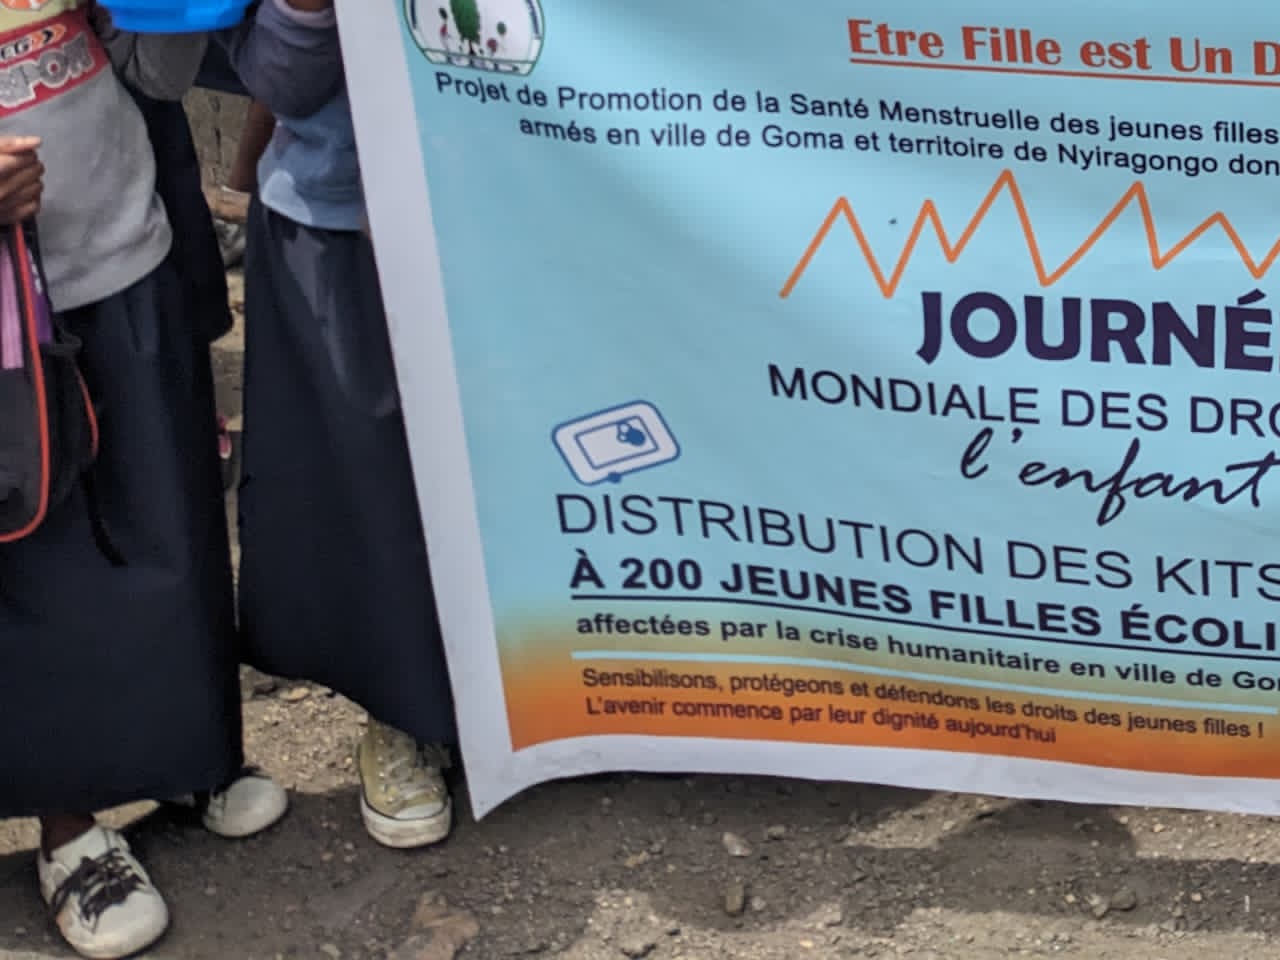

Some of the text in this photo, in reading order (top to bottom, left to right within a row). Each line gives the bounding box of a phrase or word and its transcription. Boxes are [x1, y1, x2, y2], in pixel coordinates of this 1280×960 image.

[847, 19, 945, 59] Etre
[961, 26, 1062, 66] Fille
[1080, 35, 1151, 70] est
[1169, 36, 1233, 76] Un
[435, 71, 510, 103] Projet
[517, 84, 548, 107] de
[558, 86, 702, 112] Promotion
[713, 89, 747, 112] de
[756, 90, 780, 114] la
[791, 93, 869, 119] Santé
[879, 100, 1040, 132] Menstruelle
[1050, 113, 1100, 136] des
[1108, 116, 1203, 142] jeunes
[1213, 121, 1279, 145] filles
[519, 116, 597, 144] armés
[607, 128, 640, 146] en
[650, 123, 706, 147] ville
[717, 124, 751, 148] de
[762, 125, 845, 150] Goma
[855, 131, 885, 153] et
[889, 131, 1004, 160] territoire
[1014, 137, 1048, 164] de
[1058, 142, 1219, 178] Nyiragongo
[768, 363, 1040, 425] MONDIALE
[1059, 388, 1168, 431] DES
[555, 493, 983, 575] DISTRIBUTION
[1007, 540, 1133, 589] DES
[569, 549, 606, 590] À
[620, 557, 702, 590] 200
[720, 561, 912, 615] JEUNES
[930, 589, 1102, 637] FILLES
[576, 612, 710, 637] affectées
[721, 620, 768, 643] par
[776, 616, 800, 642] la
[810, 625, 879, 652] crise
[887, 635, 1060, 675] humanitaire
[1070, 659, 1106, 679] en
[1117, 660, 1176, 685] ville
[1185, 663, 1223, 689] de
[582, 667, 725, 693] Sensibilisons,
[730, 672, 845, 700] protégeons
[850, 679, 870, 698] et
[874, 682, 981, 715] défendons
[985, 693, 1017, 716] les
[1021, 699, 1078, 724] droits
[1083, 704, 1122, 728] des
[1126, 711, 1197, 736] jeunes
[1203, 714, 1251, 738] filles
[586, 695, 1057, 744] L'avenir commence par leur dignité aujourd'hui
